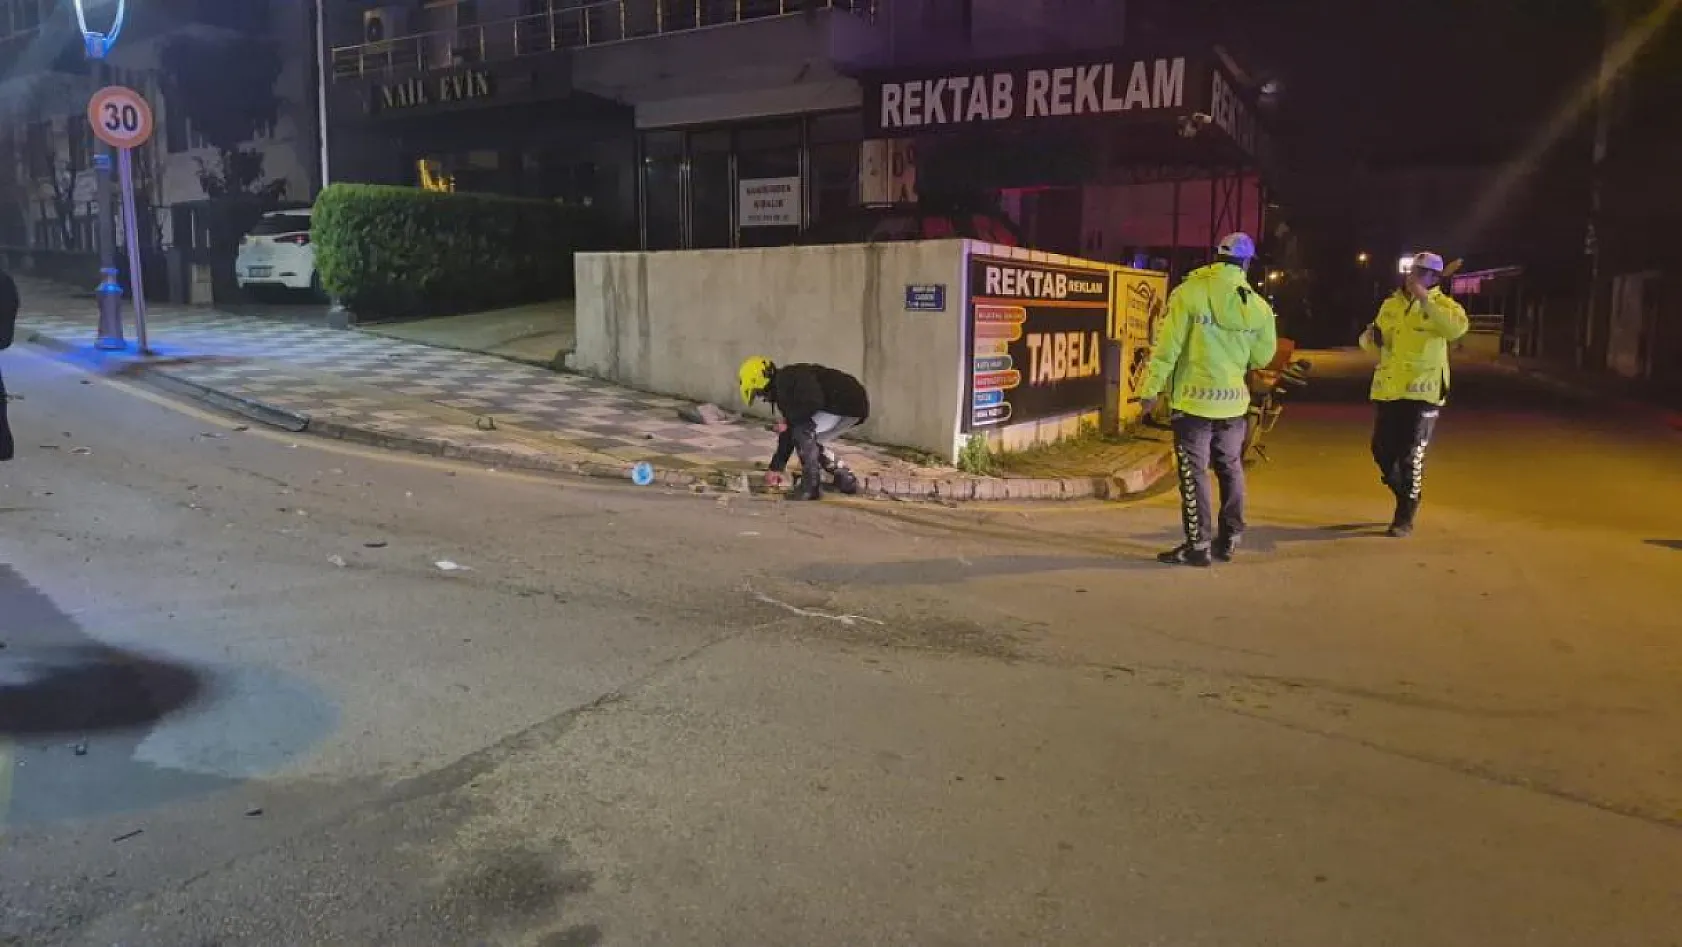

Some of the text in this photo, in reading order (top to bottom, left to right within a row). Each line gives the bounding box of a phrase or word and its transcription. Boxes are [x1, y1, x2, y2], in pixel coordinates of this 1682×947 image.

[881, 57, 1185, 128] REKTAB REKLAM
[104, 102, 138, 131] 30
[985, 265, 1103, 299] REKTAB REKLAM
[1026, 331, 1100, 385] TABELA
